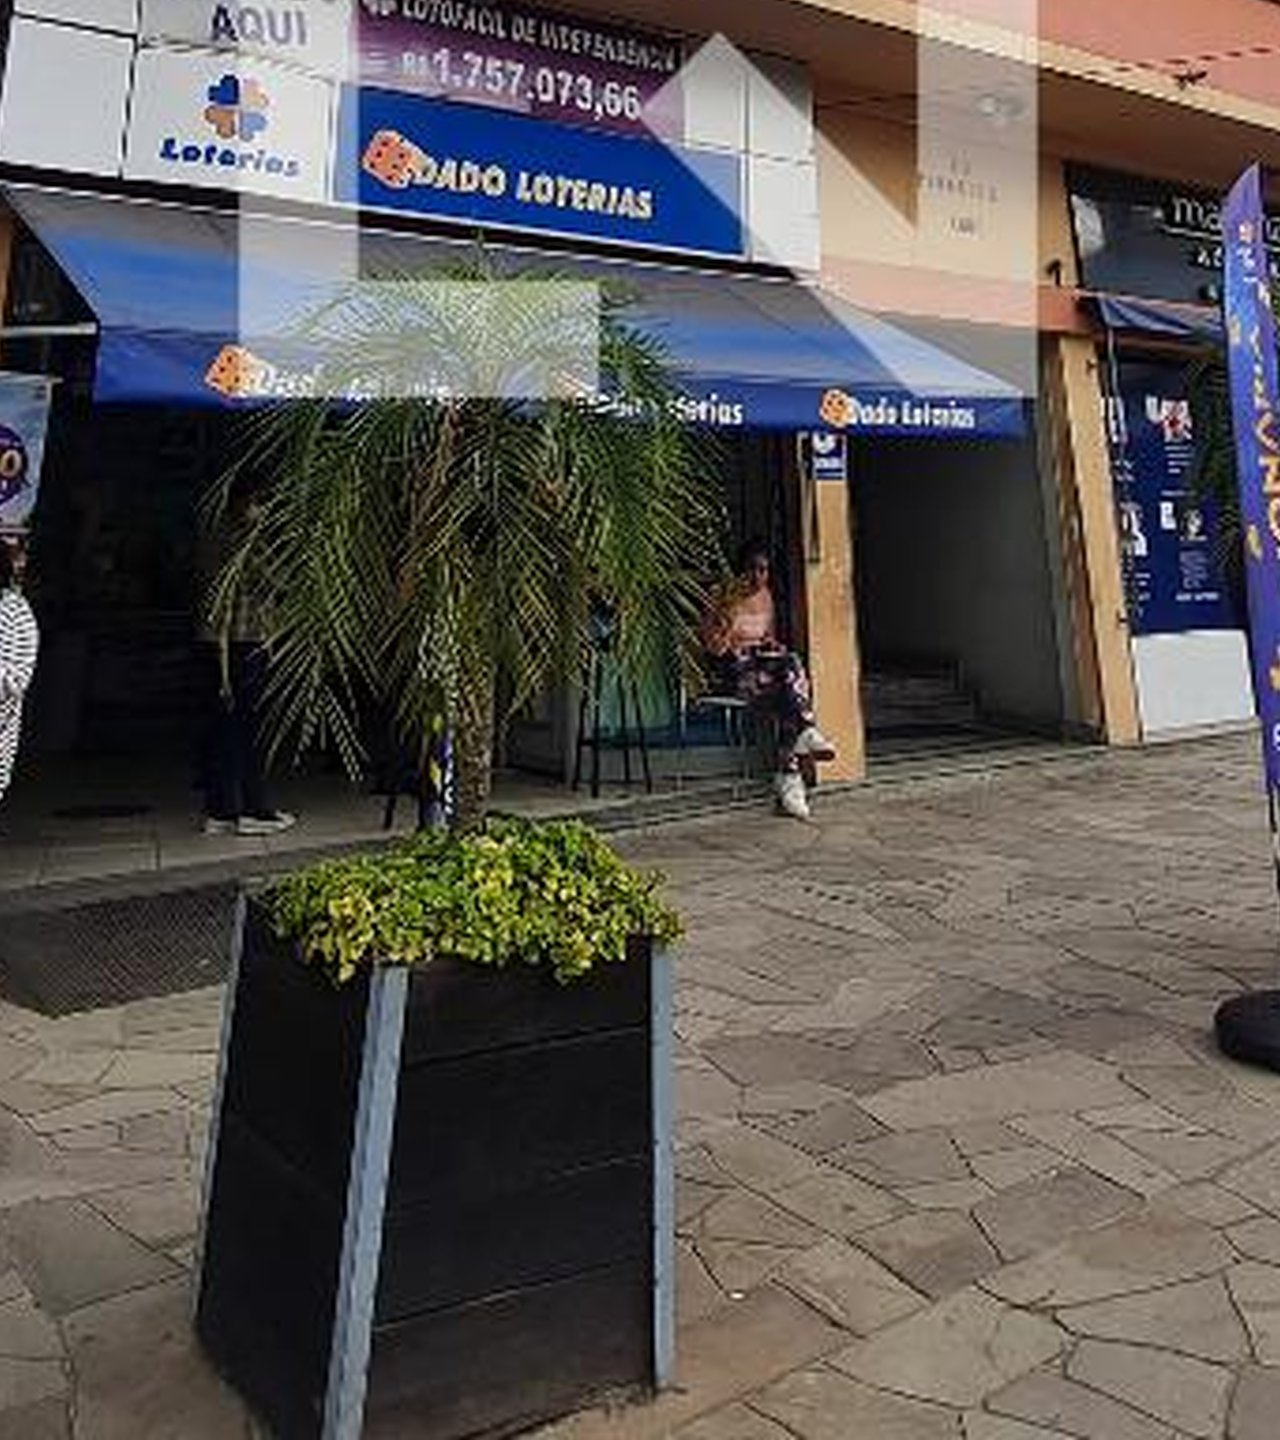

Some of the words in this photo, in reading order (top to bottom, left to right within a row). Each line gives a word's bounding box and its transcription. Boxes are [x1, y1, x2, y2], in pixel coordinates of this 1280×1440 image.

[210, 1, 309, 47] AQUI
[431, 46, 643, 122] 1.757.073,66
[158, 137, 300, 178] Loterias
[417, 152, 507, 199] DADO
[516, 166, 654, 221] LOTERIAS
[847, 398, 896, 426] Dado
[902, 400, 977, 430] Loterias
